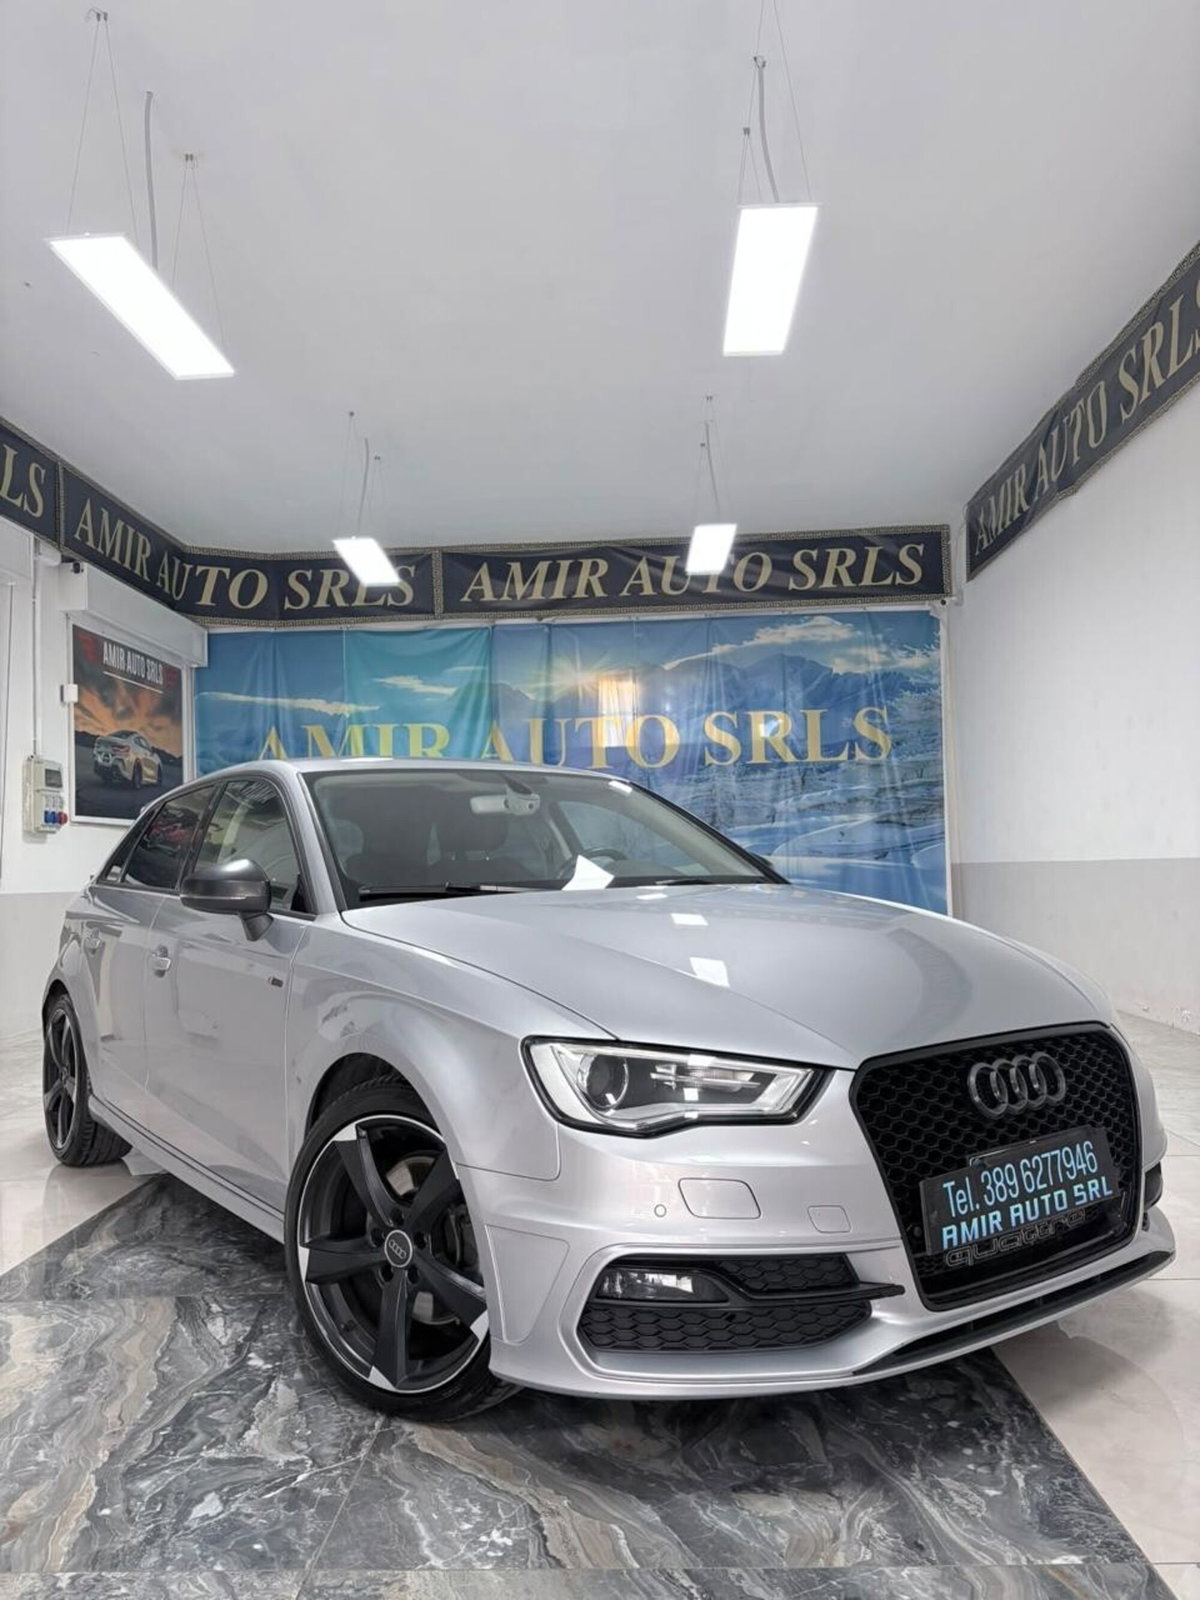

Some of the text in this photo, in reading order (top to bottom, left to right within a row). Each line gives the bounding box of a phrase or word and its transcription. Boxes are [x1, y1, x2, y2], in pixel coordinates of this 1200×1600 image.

[974, 279, 1200, 557] AMIR AUTO SRL
[74, 498, 151, 582] AMIR
[156, 551, 269, 610] AUTO
[460, 557, 608, 603] AMIR
[788, 543, 925, 592] SRLS
[102, 640, 125, 673] AMIR
[126, 650, 146, 679] AUTO
[257, 705, 892, 769] AMIR AUTO SRLS
[942, 1140, 1099, 1218] Tel. 389 6277946
[942, 1175, 1114, 1250] AMIR AUTO SRL
